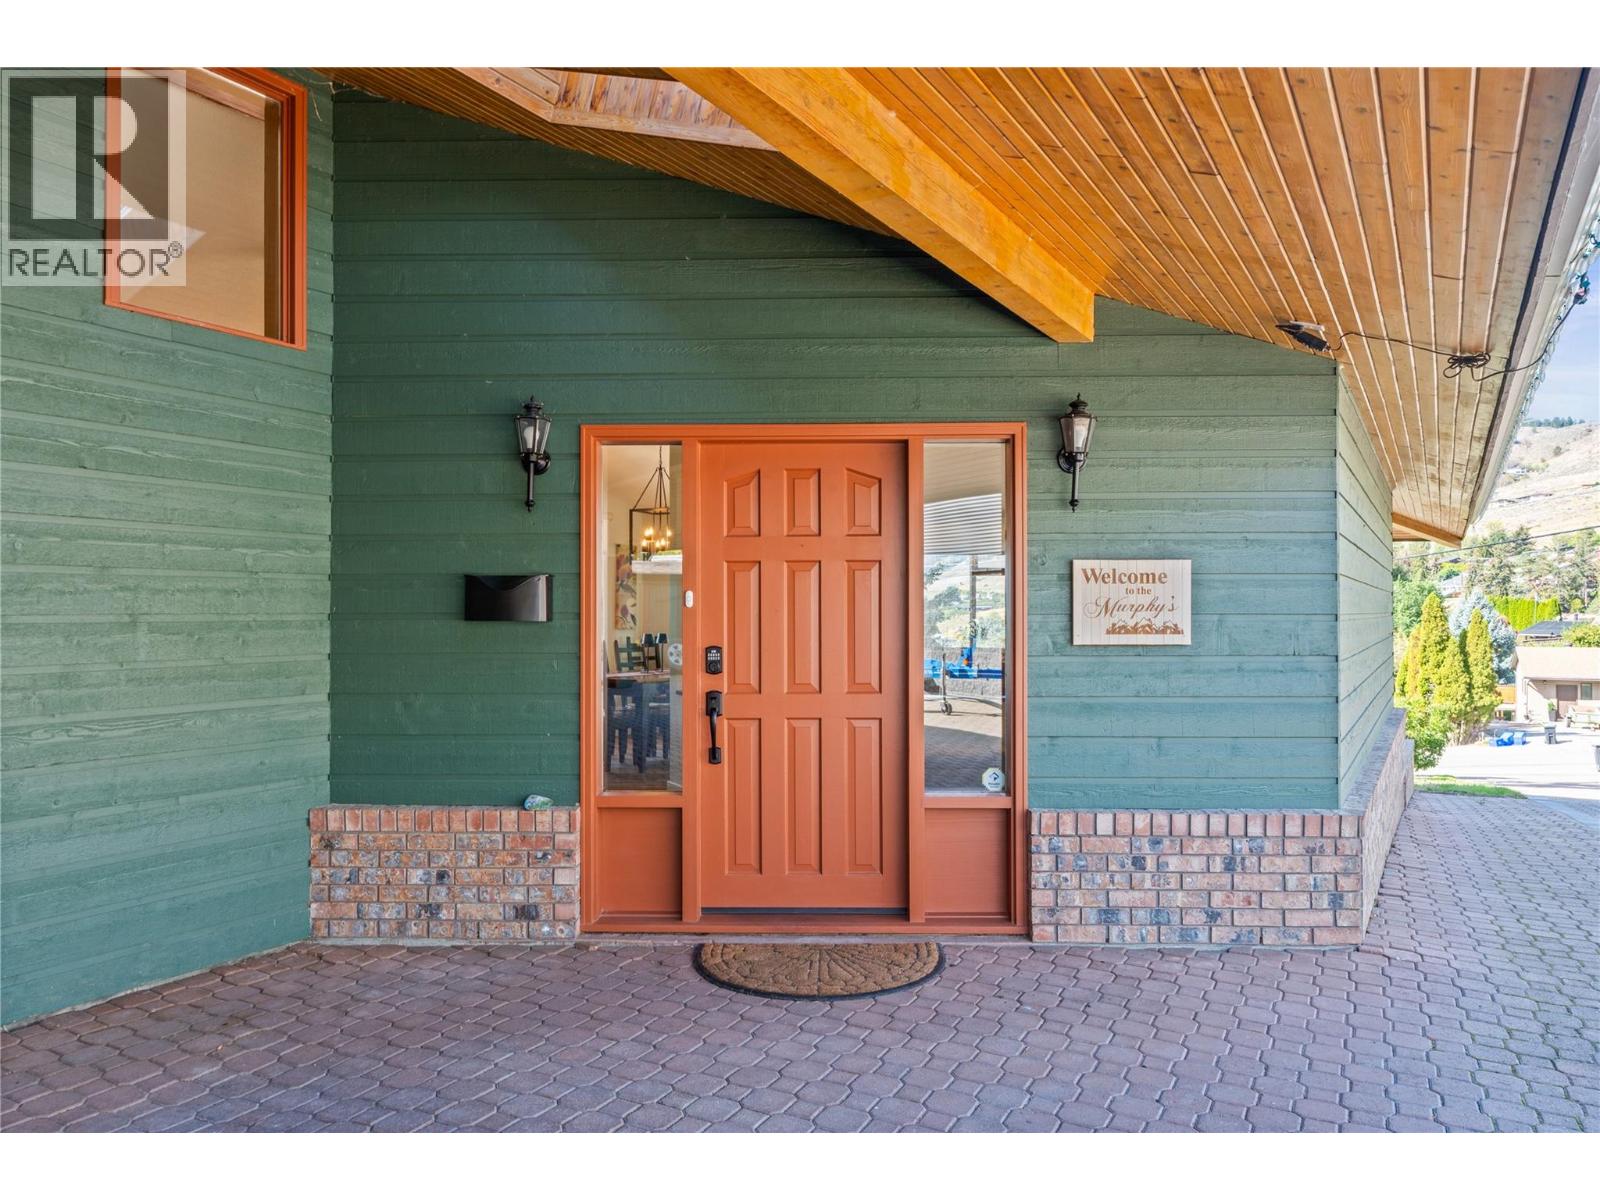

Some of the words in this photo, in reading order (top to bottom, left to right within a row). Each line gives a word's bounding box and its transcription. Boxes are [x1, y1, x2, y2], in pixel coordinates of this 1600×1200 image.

[1081, 568, 1168, 584] Welcome
[1125, 587, 1134, 595] to
[1136, 586, 1152, 595] the
[1083, 595, 1179, 619] Murphy's
